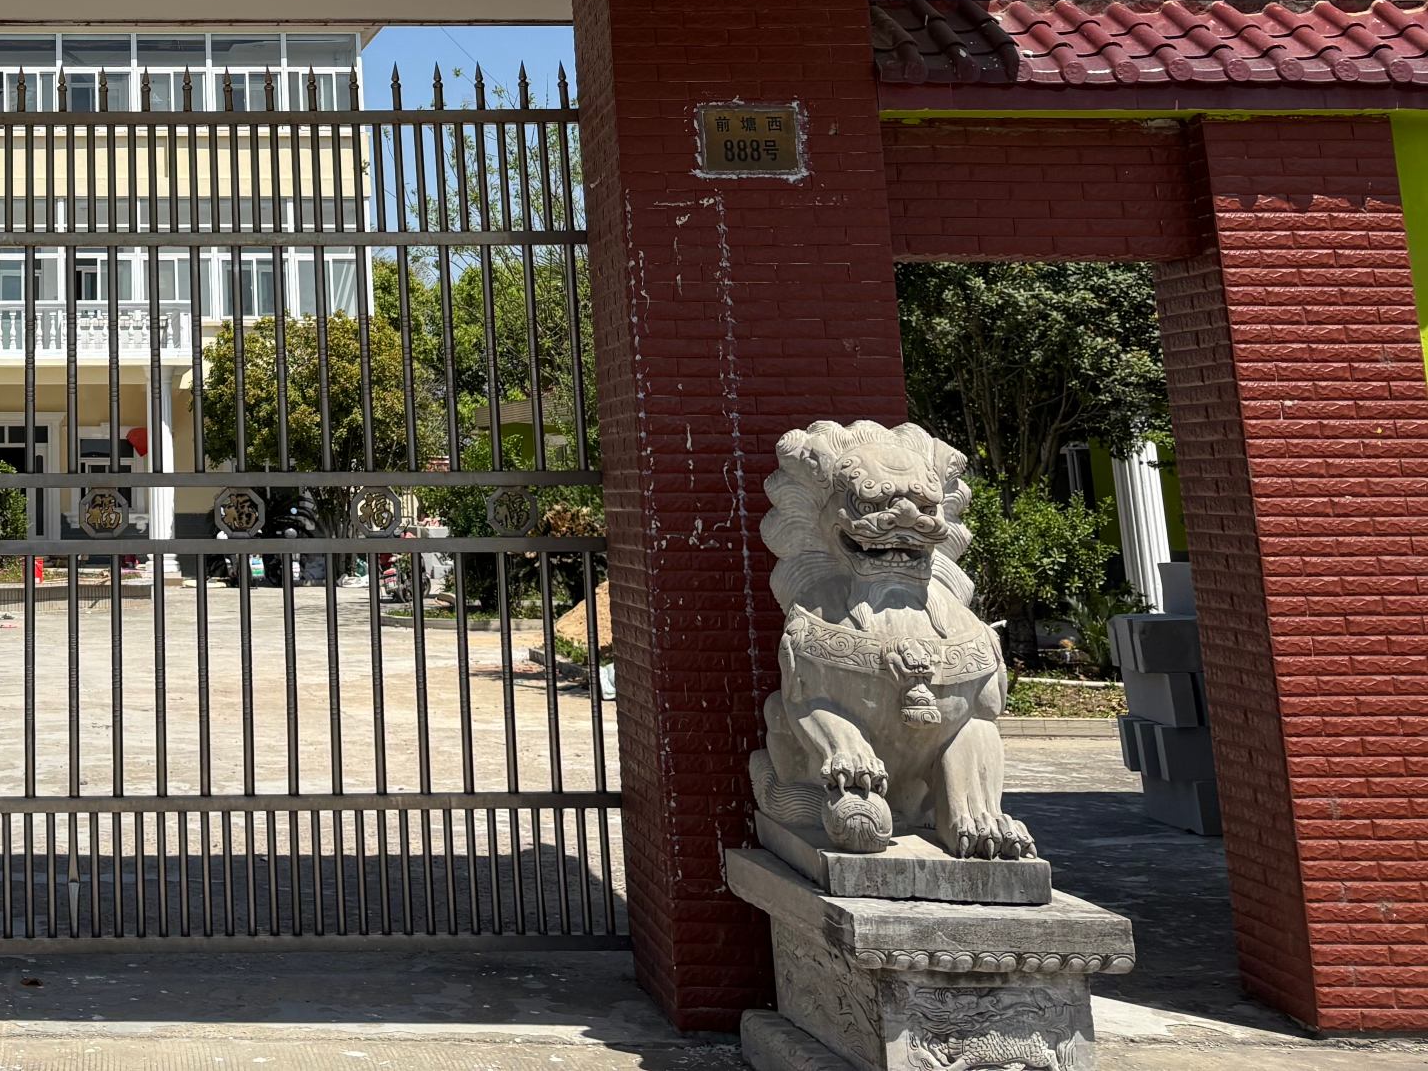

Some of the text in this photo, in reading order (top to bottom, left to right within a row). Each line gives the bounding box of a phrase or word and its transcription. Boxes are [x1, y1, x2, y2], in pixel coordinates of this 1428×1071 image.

[715, 116, 783, 132] 前塘西
[723, 139, 780, 162] 888号
[86, 494, 122, 529] 福
[358, 492, 393, 529] 福
